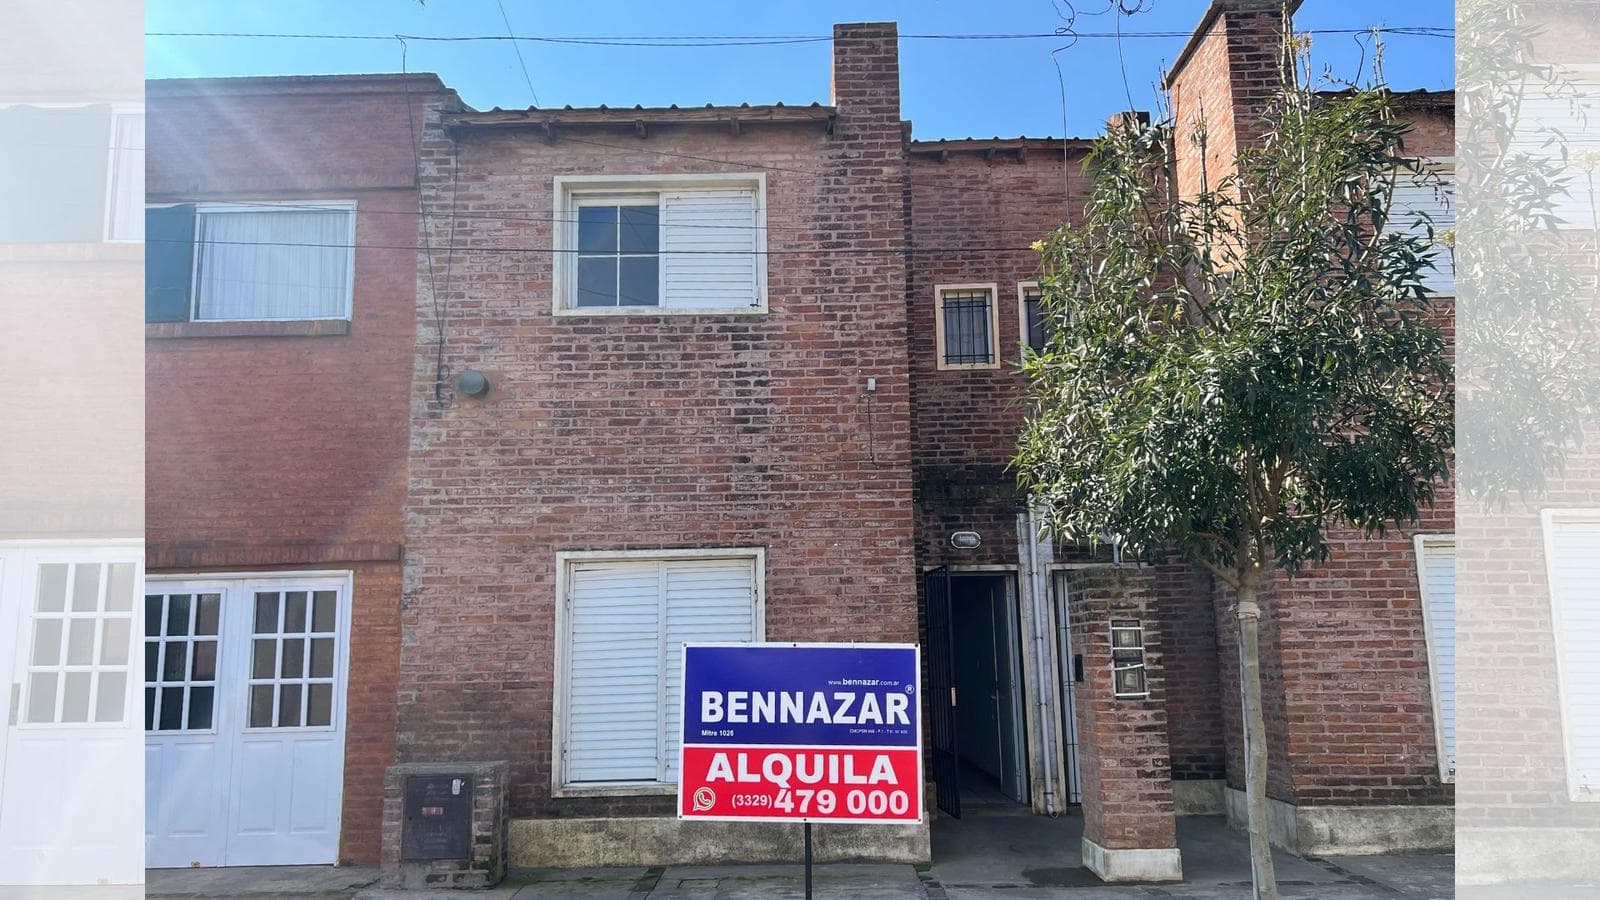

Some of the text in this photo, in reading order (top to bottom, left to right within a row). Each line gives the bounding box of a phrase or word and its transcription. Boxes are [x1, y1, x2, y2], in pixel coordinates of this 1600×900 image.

[701, 729, 718, 737] Mitre
[706, 752, 898, 788] ALQUILA
[731, 788, 909, 815] (3329) 479 000
